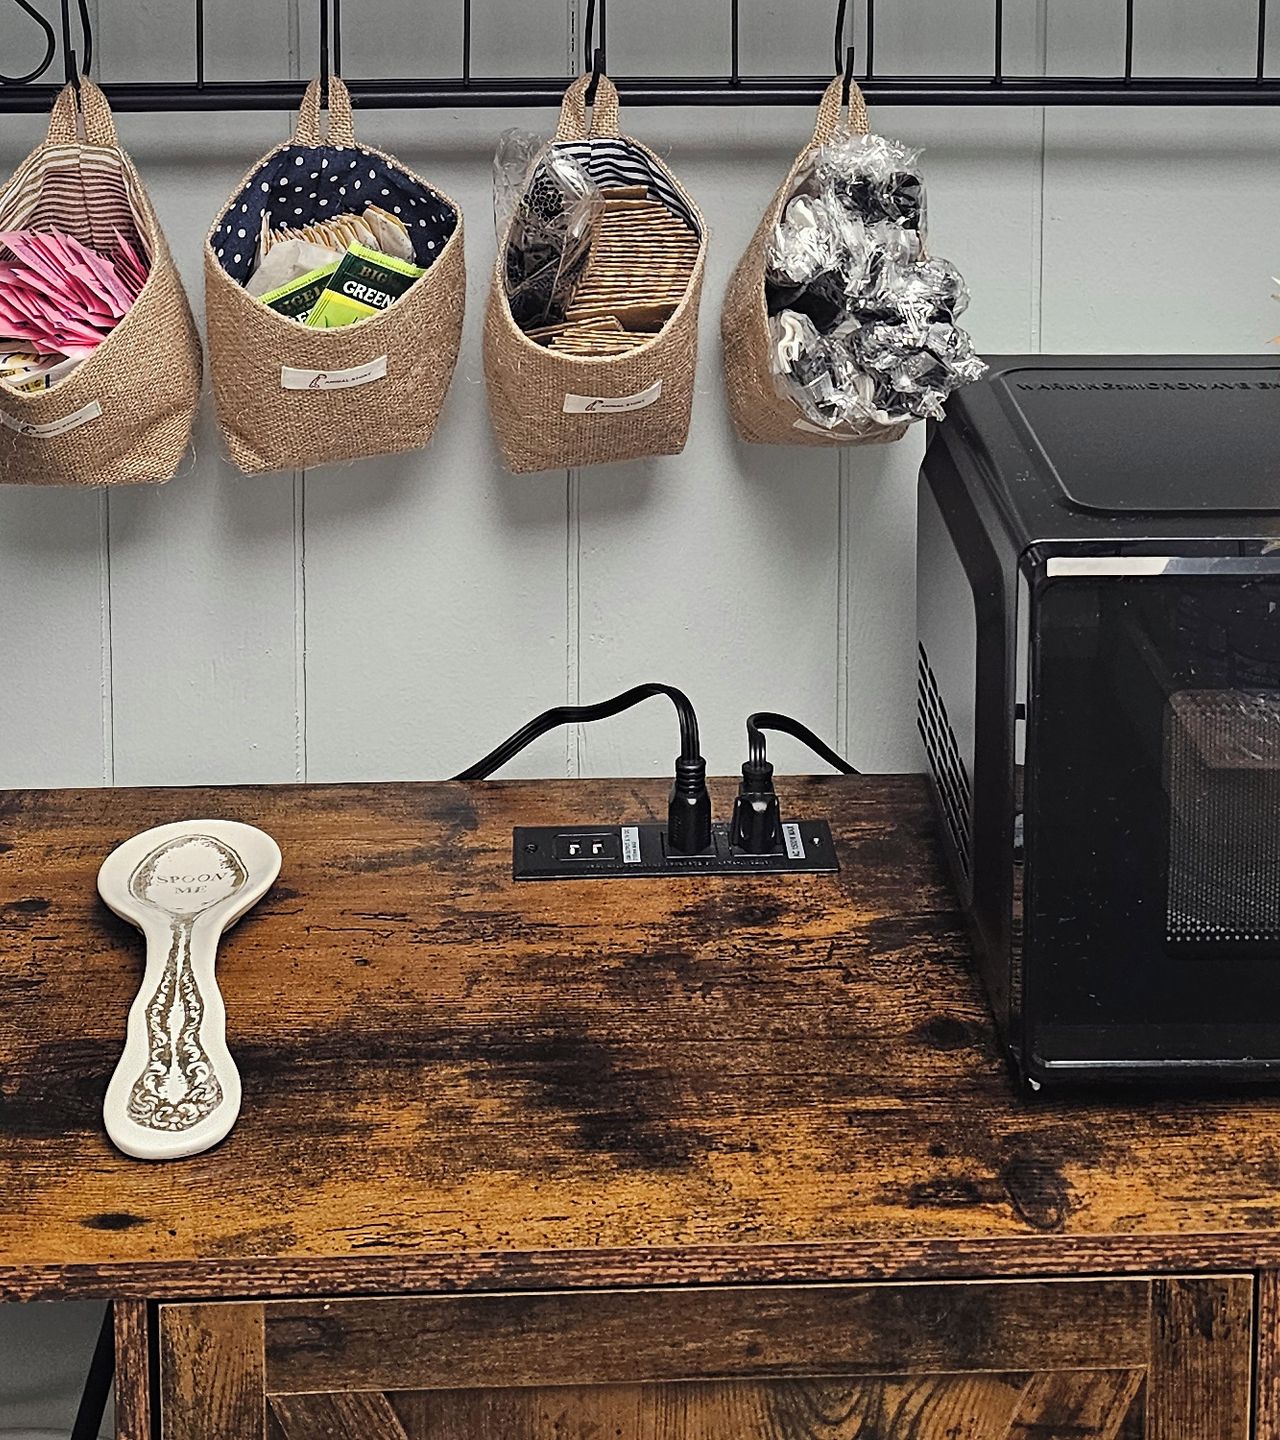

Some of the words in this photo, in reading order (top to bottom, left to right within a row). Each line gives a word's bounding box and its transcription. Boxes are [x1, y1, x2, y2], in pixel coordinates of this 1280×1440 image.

[343, 280, 395, 308] GREEN
[156, 872, 226, 885] SPOON
[175, 885, 208, 894] ME
